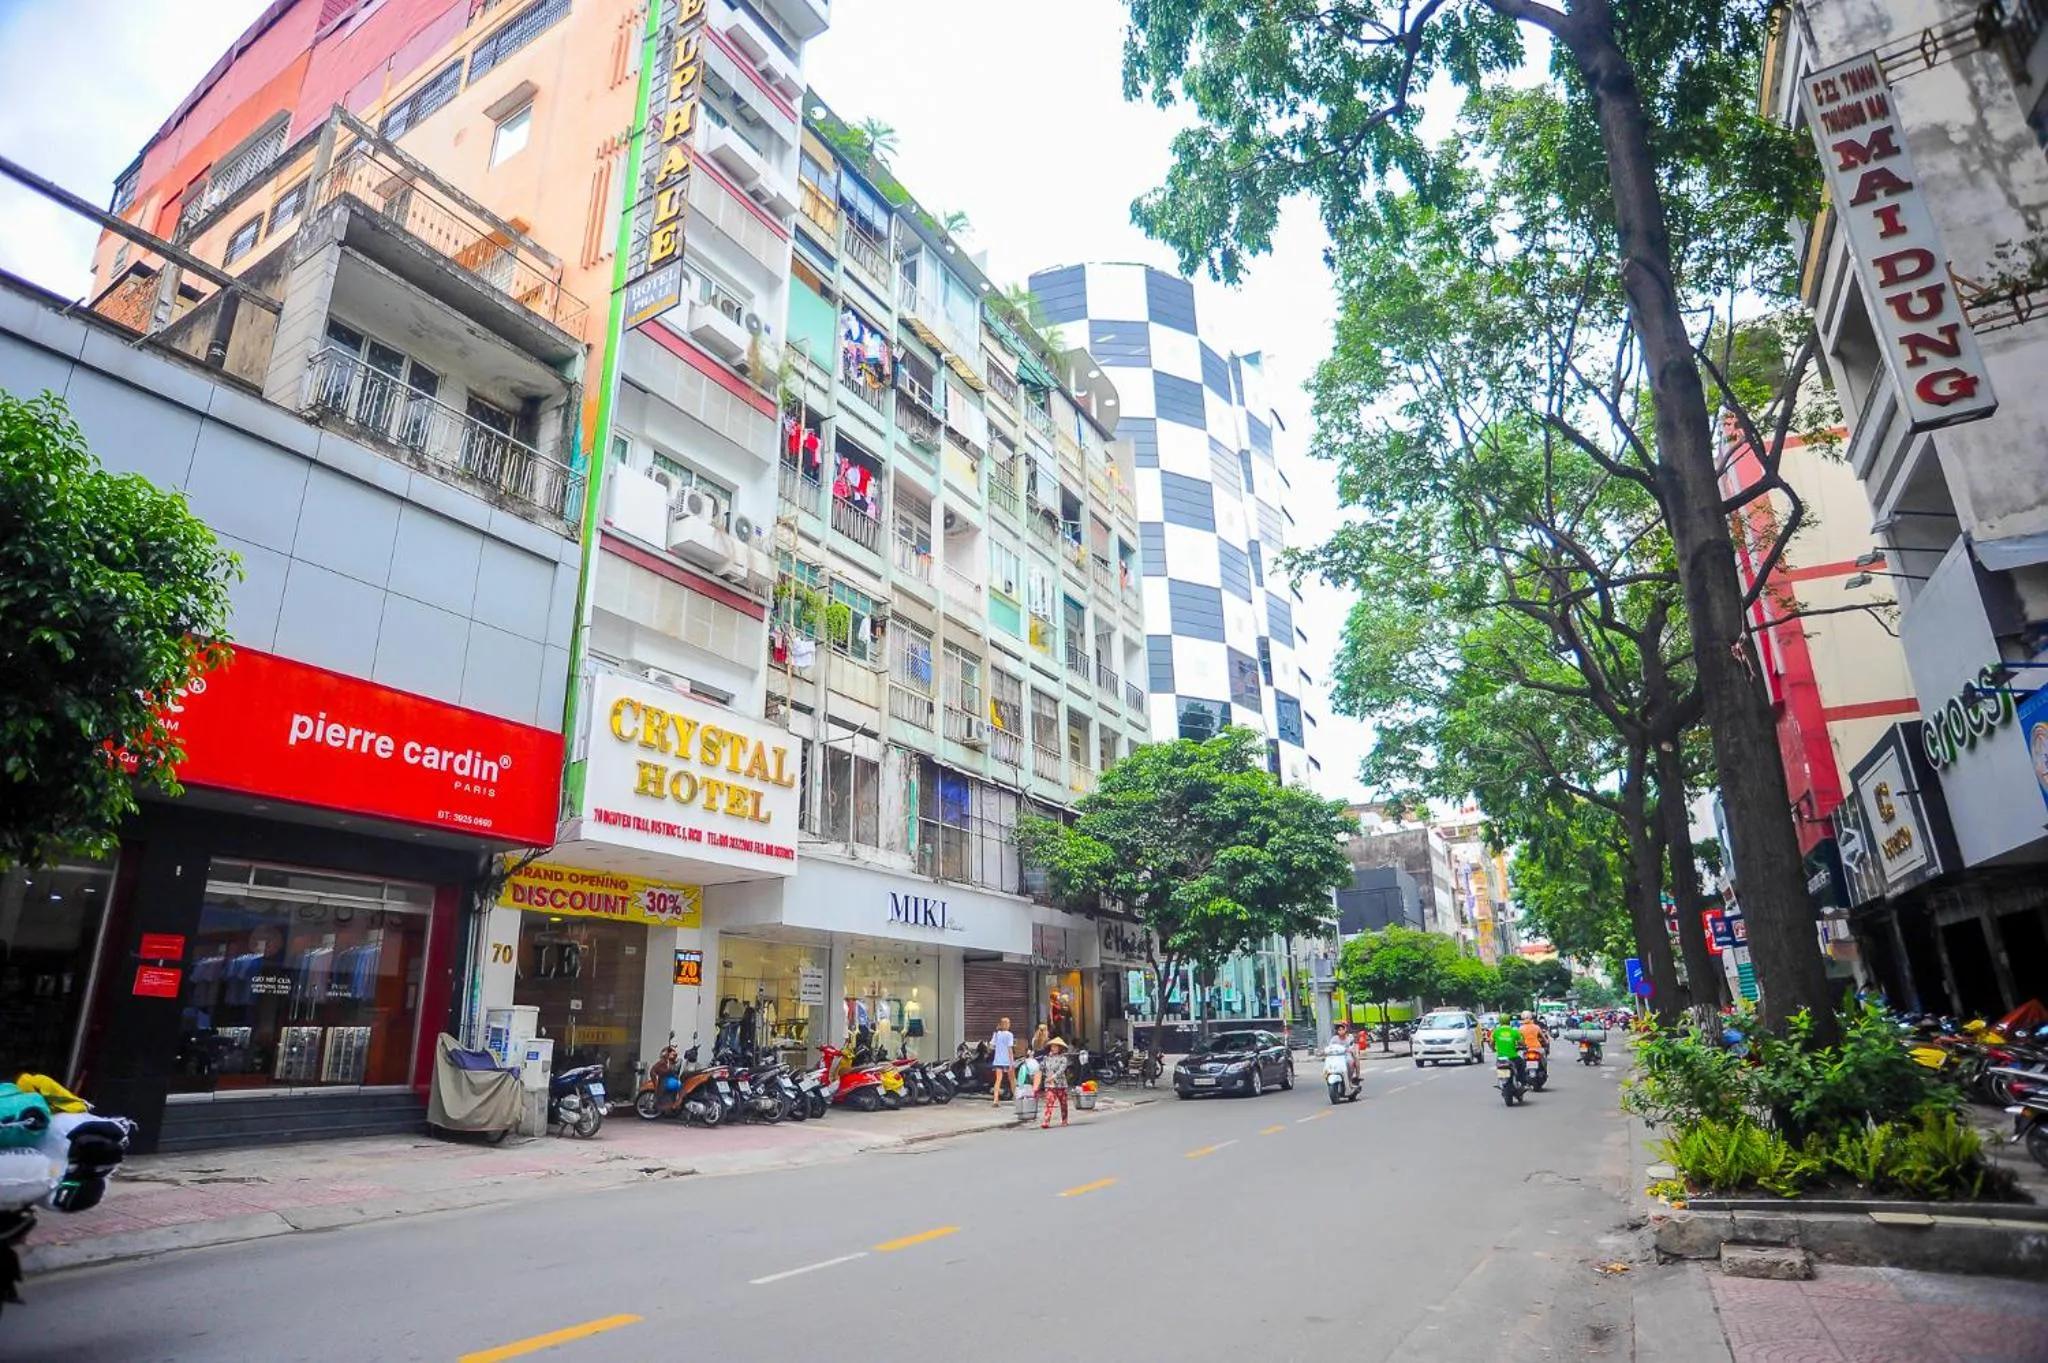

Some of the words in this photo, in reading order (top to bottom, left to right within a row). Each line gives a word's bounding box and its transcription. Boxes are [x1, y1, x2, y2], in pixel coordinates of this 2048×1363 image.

[288, 712, 395, 759] pierre
[609, 695, 796, 788] CRYSTAL
[454, 781, 497, 798] PARIS
[633, 759, 773, 825] HOTEL
[568, 872, 629, 891] OPENING
[512, 883, 630, 916] DISCOUNT
[645, 890, 682, 916] 30%
[888, 891, 947, 929] MIKI
[492, 943, 514, 965] 70
[680, 961, 698, 978] 70
